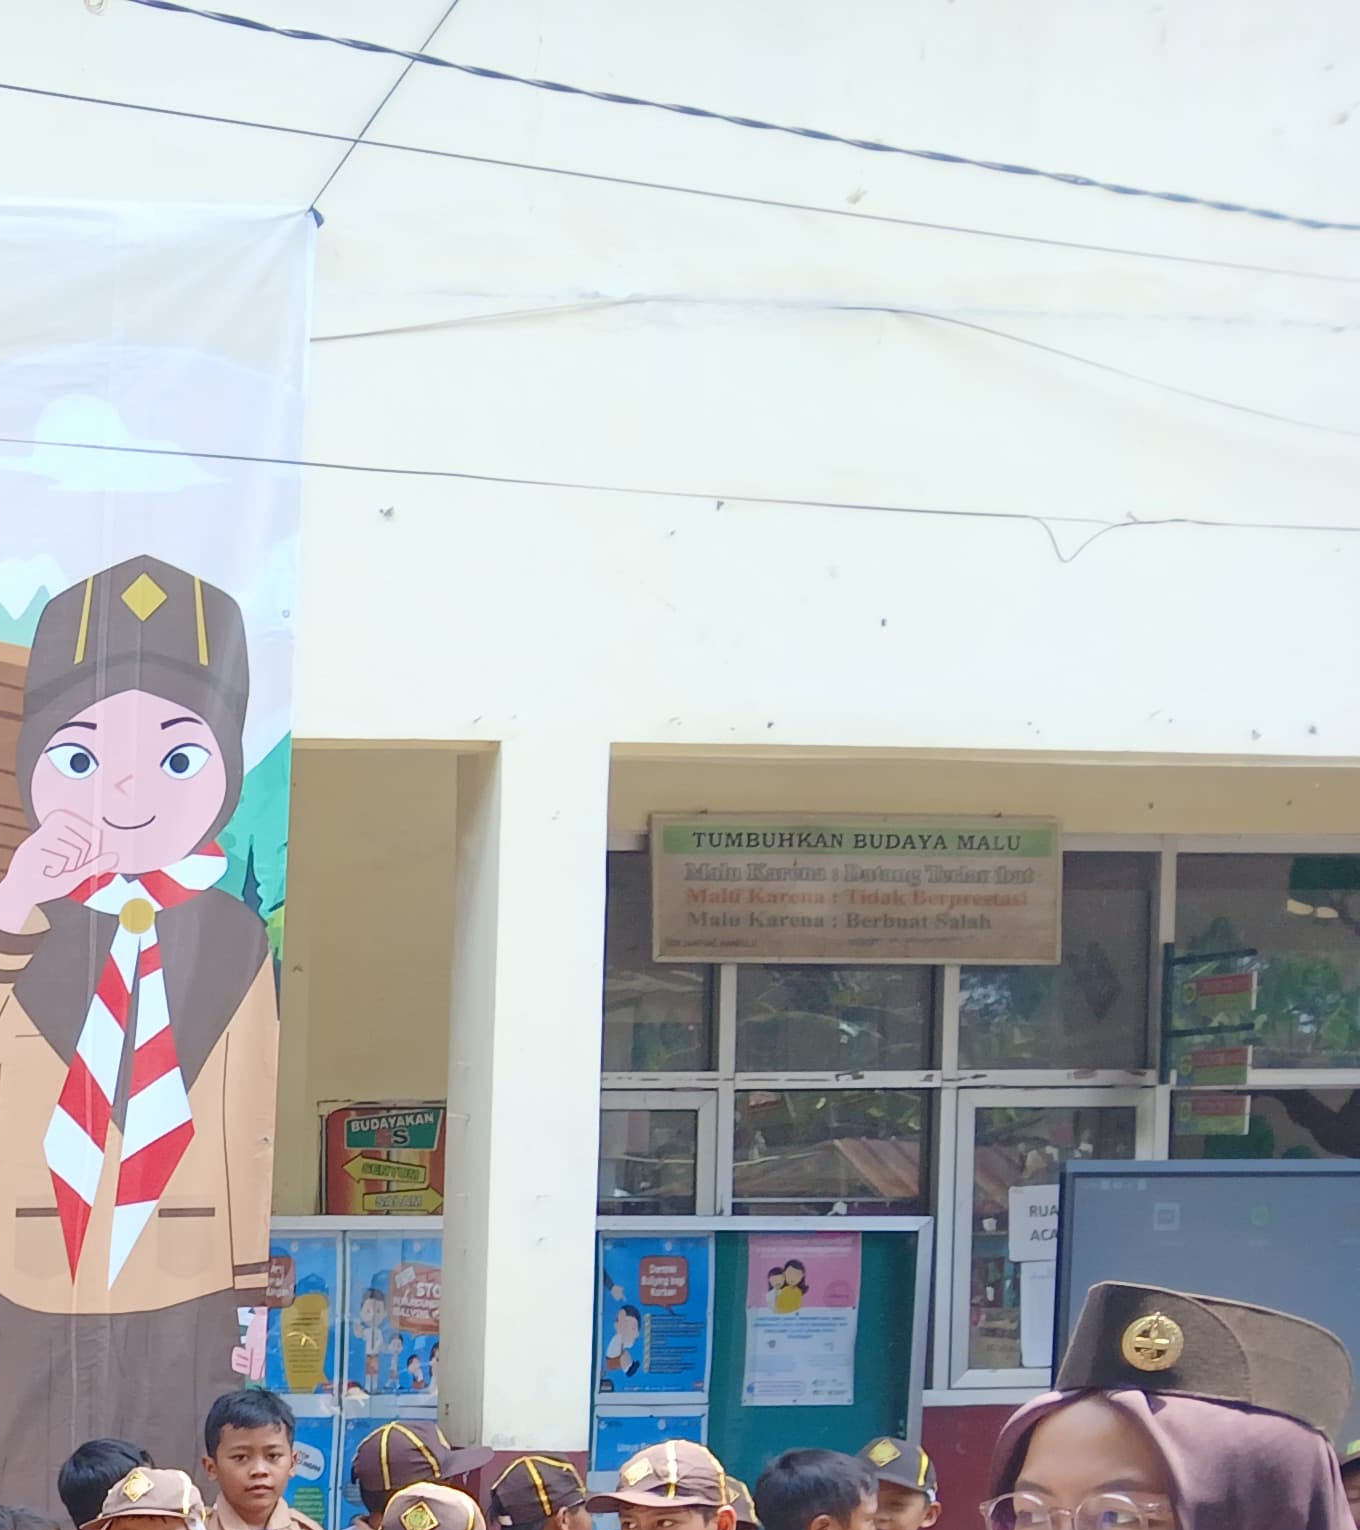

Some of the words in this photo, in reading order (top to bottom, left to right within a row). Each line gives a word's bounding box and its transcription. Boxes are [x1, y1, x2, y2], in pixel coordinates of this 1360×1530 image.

[693, 831, 844, 849] TUMBUHKAN
[853, 833, 949, 851] BUDAYA
[957, 835, 1022, 852] MALU
[687, 912, 740, 928] Malu
[749, 912, 824, 928] Karena
[846, 912, 928, 929] Berbuat
[935, 913, 992, 929] Salah
[351, 1112, 434, 1132] BUDAYAKAN
[1029, 1205, 1059, 1218] RUA
[1030, 1229, 1059, 1241] ACA
[416, 1282, 440, 1297] STO
